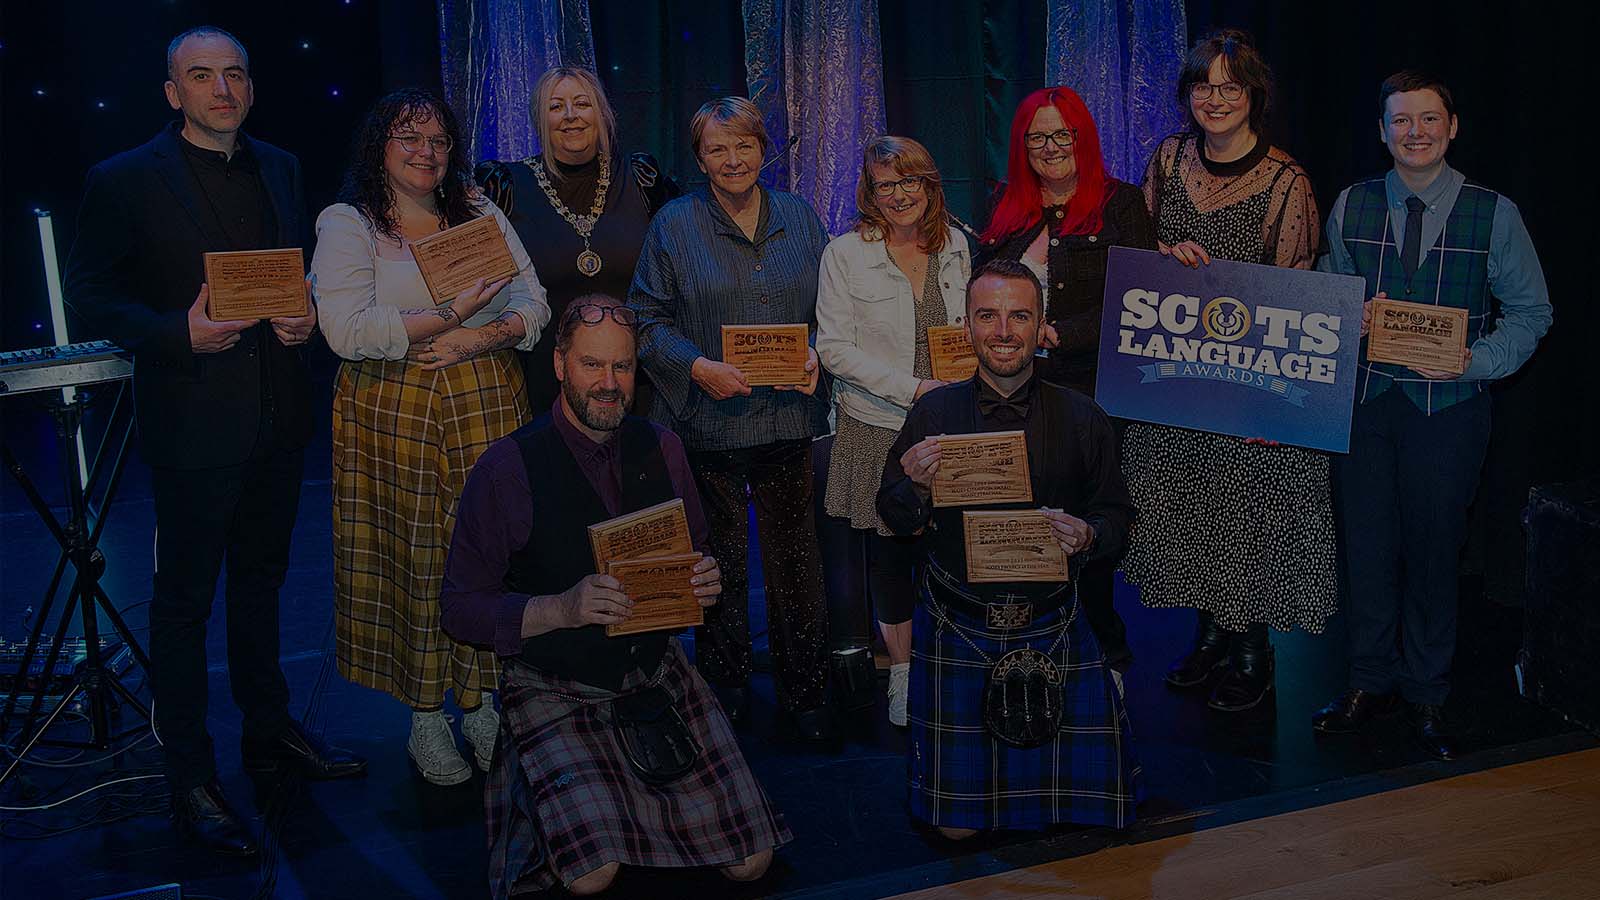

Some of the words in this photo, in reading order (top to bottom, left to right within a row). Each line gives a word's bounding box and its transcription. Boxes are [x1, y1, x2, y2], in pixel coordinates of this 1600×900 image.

[1120, 288, 1342, 355] SCOTS
[1384, 309, 1454, 330] SCOTS
[1117, 329, 1337, 385] LANGUAGE
[1183, 364, 1265, 387] AWARDS
